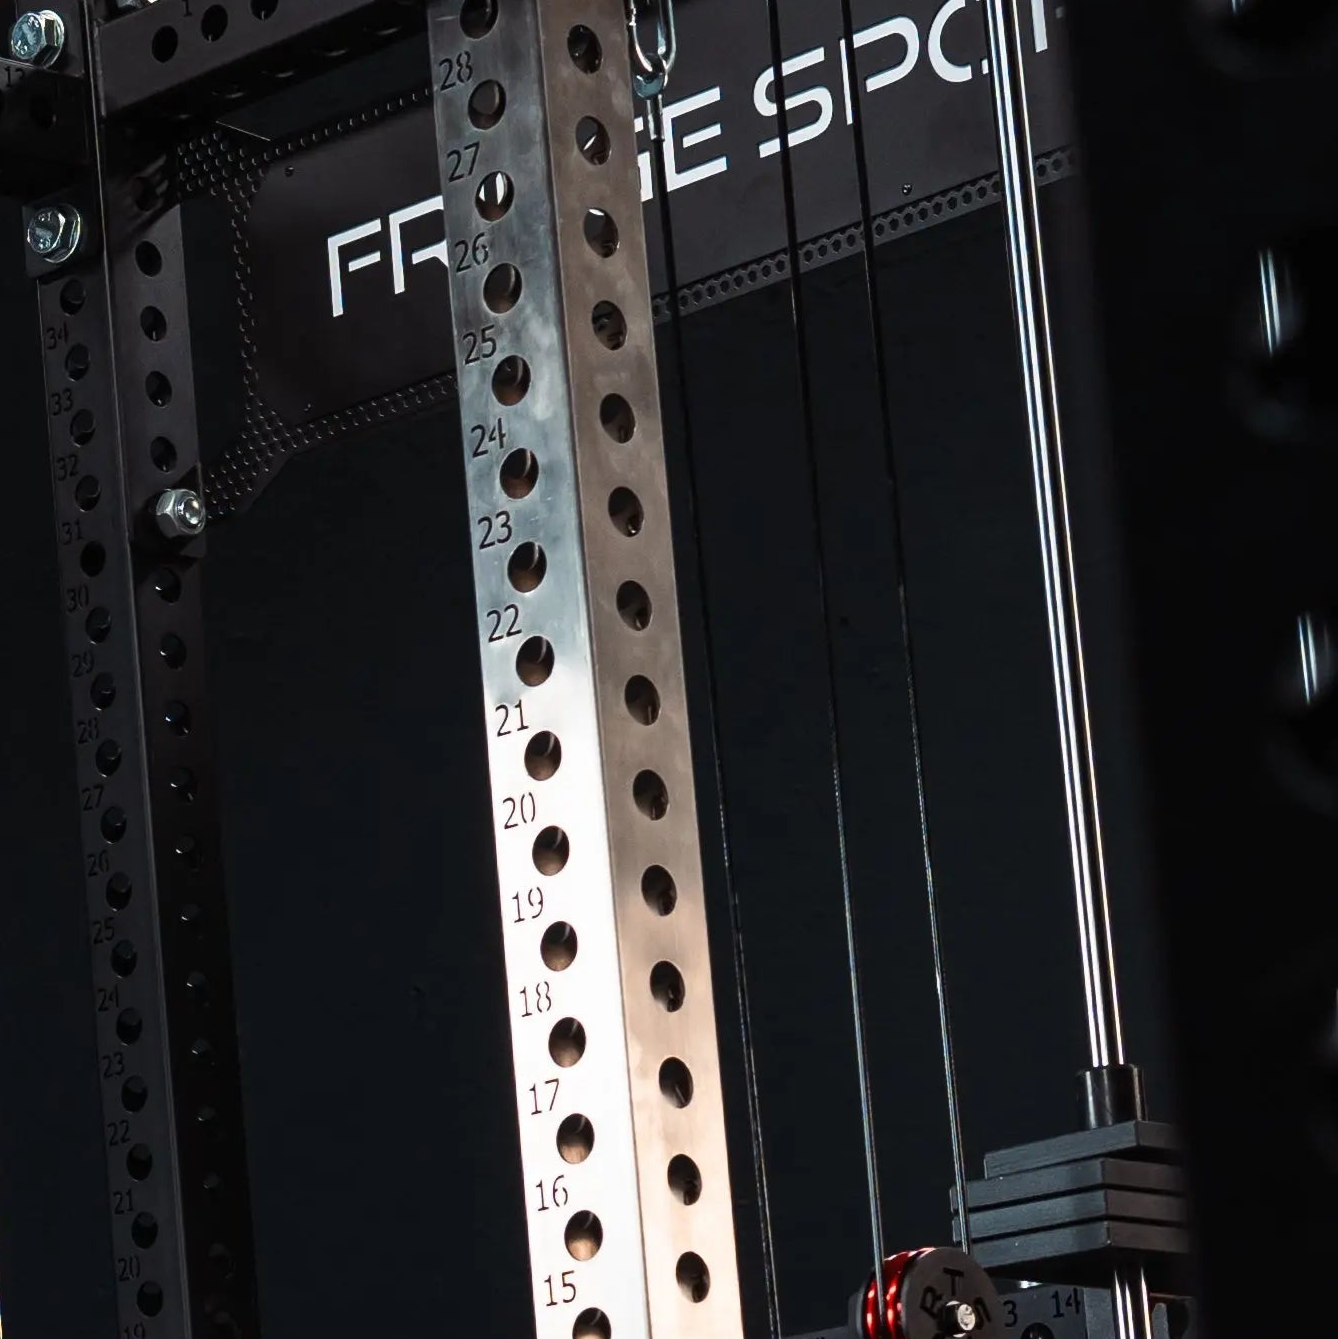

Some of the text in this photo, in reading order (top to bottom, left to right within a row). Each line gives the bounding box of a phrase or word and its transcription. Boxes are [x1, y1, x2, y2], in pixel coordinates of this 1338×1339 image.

[439, 51, 474, 92] 28
[447, 143, 480, 182] 27
[327, 86, 727, 318] FRE
[455, 233, 489, 273] 26
[46, 322, 69, 350] 34
[462, 325, 497, 365] 25
[51, 388, 74, 416] 33
[471, 418, 506, 458] 24
[57, 453, 79, 481] 32
[61, 520, 83, 546] 31
[477, 510, 513, 549] 23
[486, 603, 523, 643] 22
[495, 699, 529, 737] 21
[82, 783, 105, 811] 27
[503, 792, 536, 830] 20
[512, 886, 544, 923] 19
[92, 916, 115, 944] 25
[519, 981, 552, 1017] 18
[102, 1051, 125, 1079] 23
[529, 1078, 560, 1115] 17
[107, 1119, 131, 1147] 22
[535, 1175, 568, 1211] 16
[118, 1254, 141, 1282] 20
[543, 1270, 577, 1307] 15
[1051, 1288, 1080, 1318] 14
